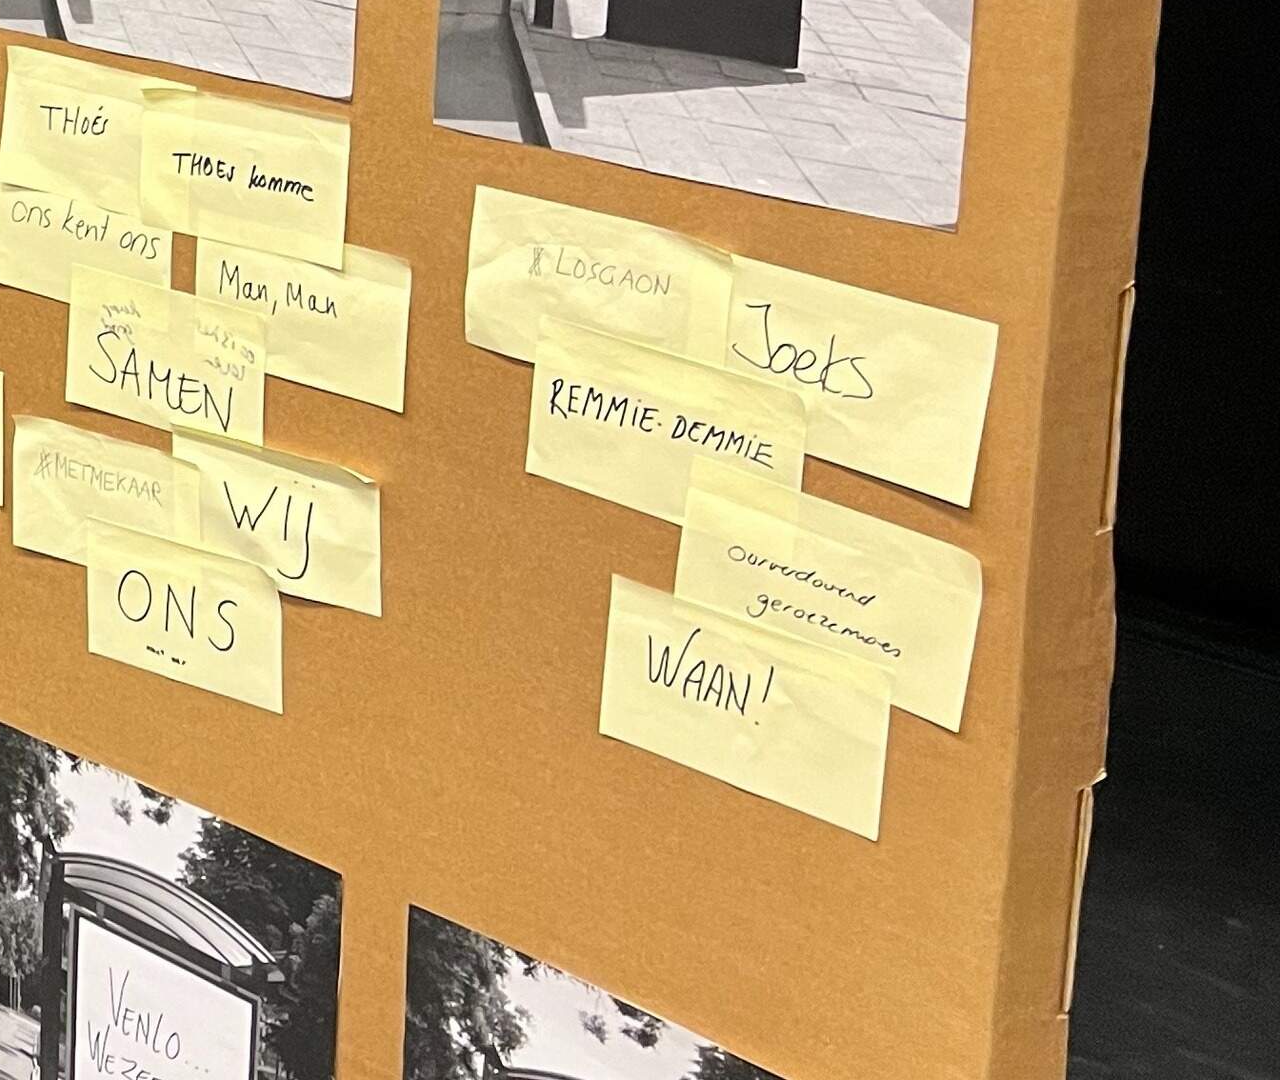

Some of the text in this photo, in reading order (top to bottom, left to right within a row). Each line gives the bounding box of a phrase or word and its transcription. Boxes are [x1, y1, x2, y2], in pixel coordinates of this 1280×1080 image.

[11, 198, 158, 261] ons kent ons
[285, 281, 338, 320] Man
[88, 330, 233, 433] SAMEN
[117, 569, 238, 652] ONS
